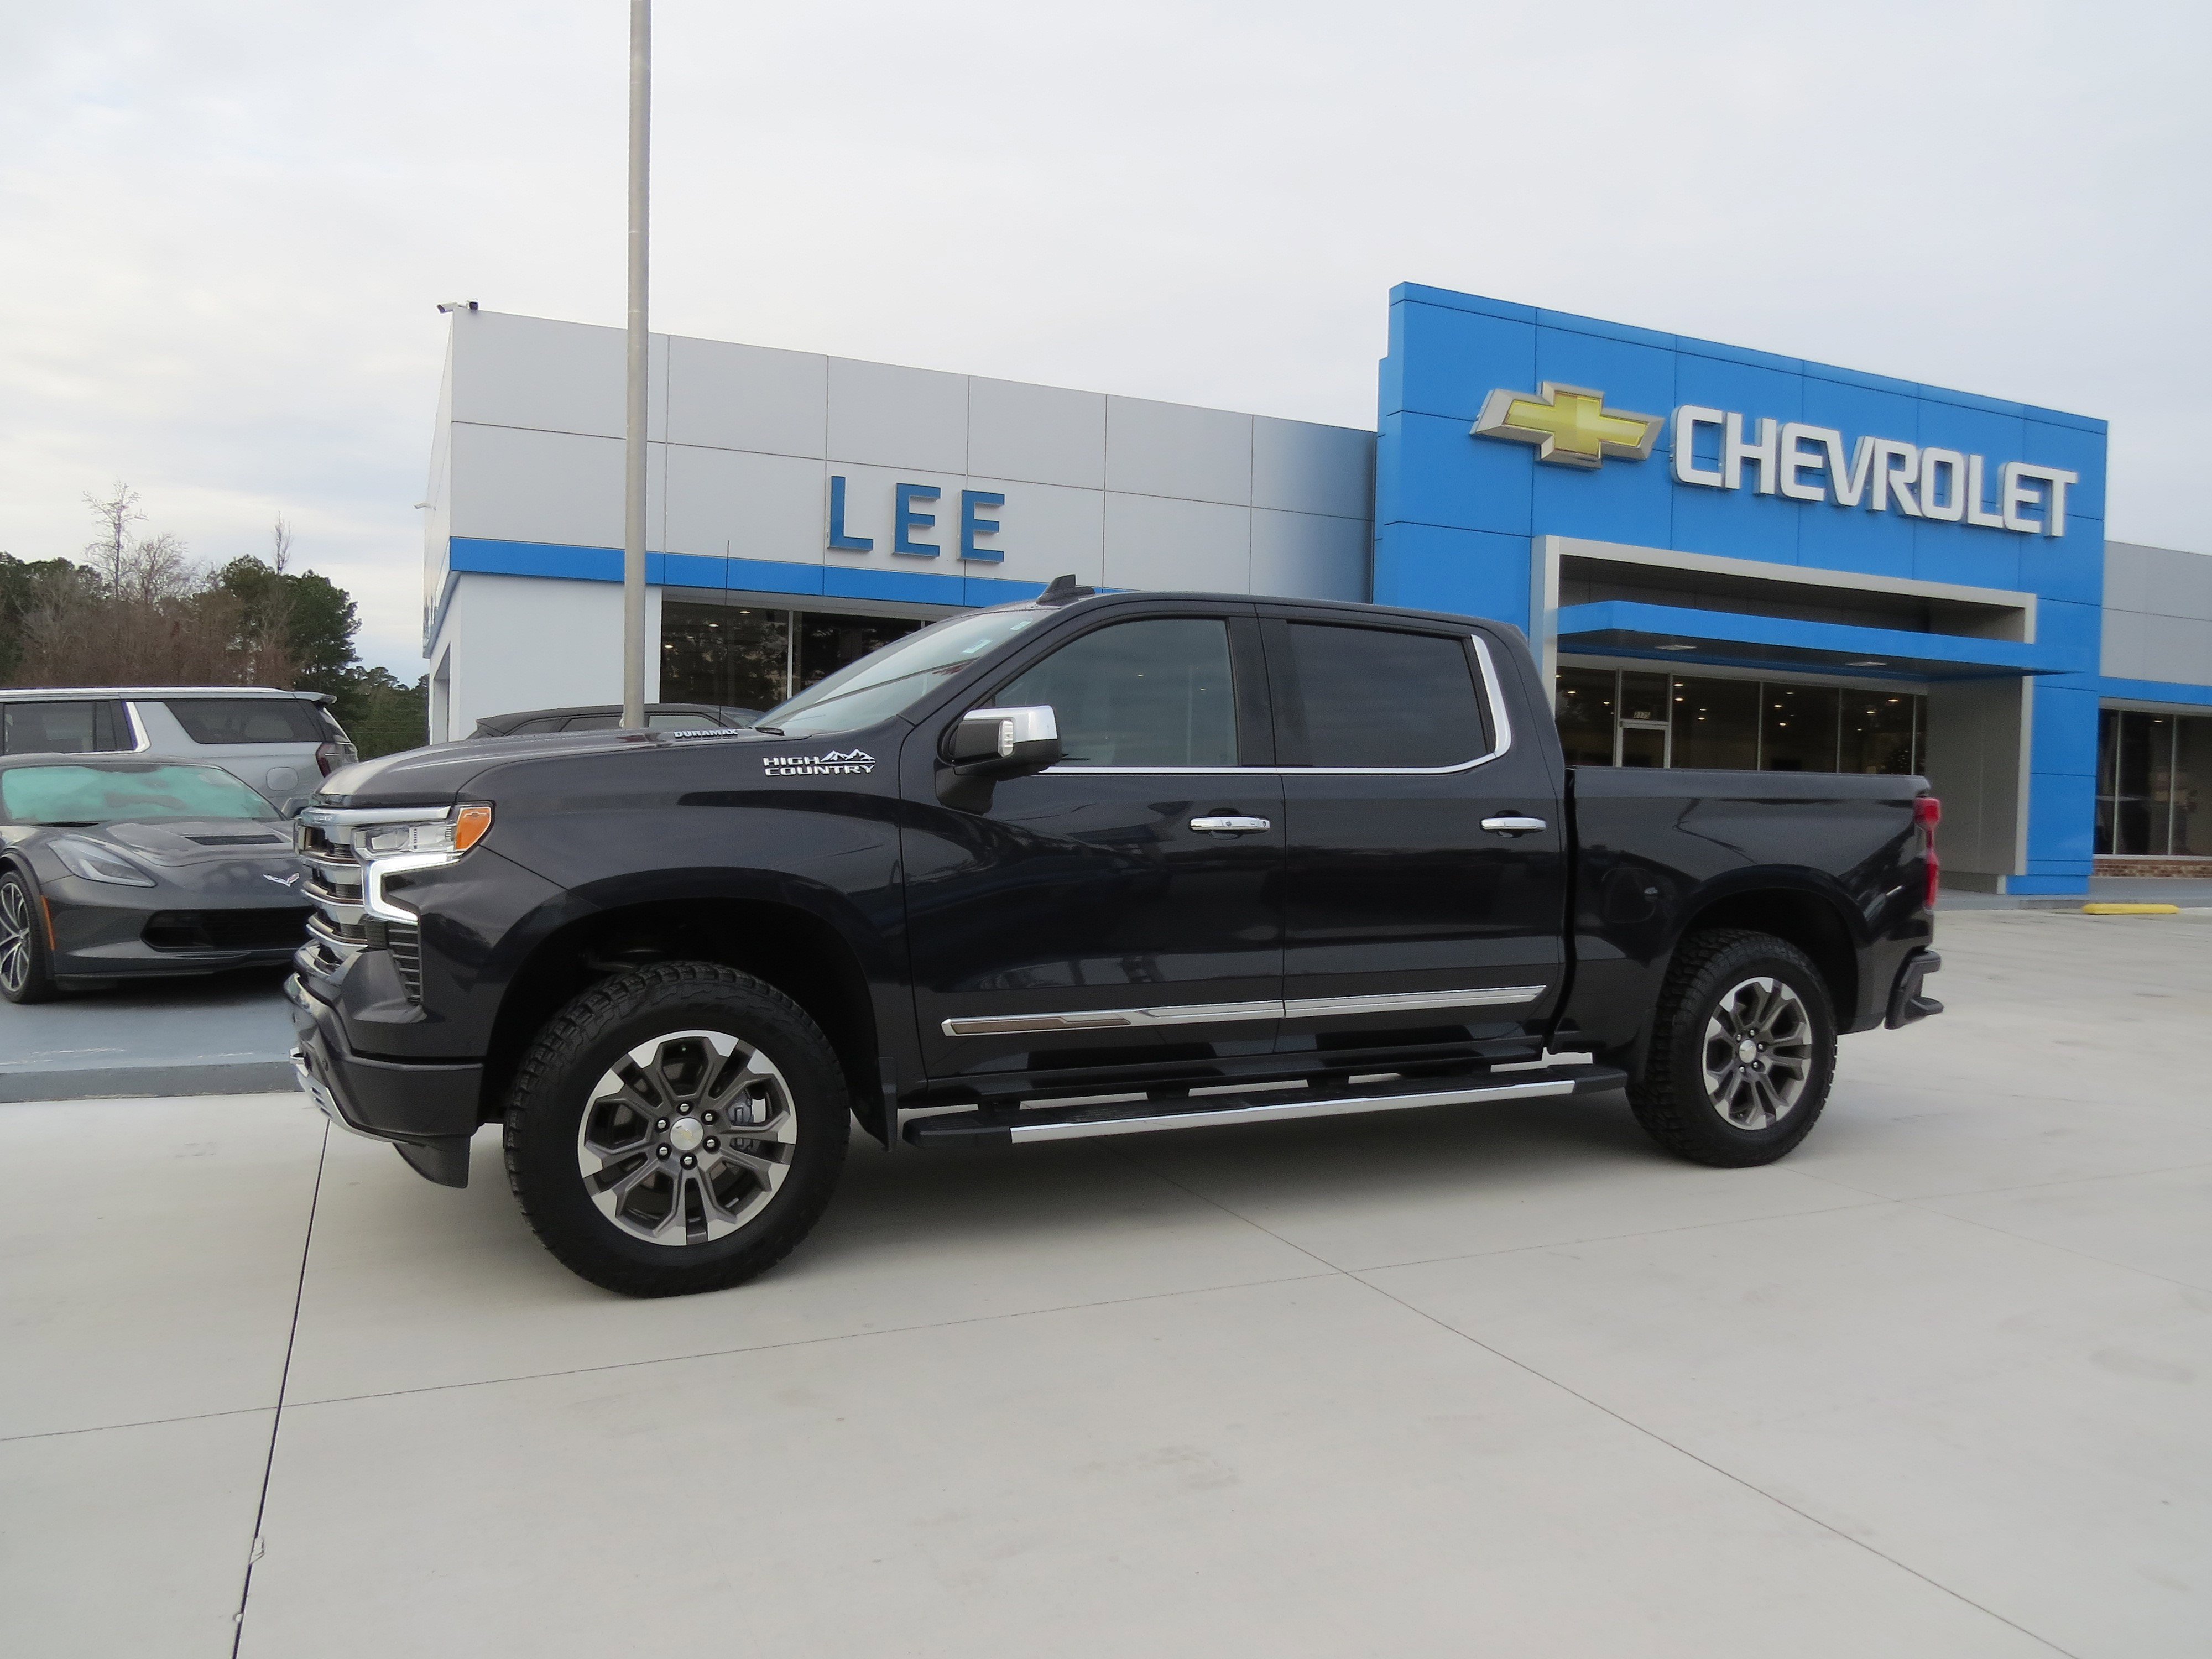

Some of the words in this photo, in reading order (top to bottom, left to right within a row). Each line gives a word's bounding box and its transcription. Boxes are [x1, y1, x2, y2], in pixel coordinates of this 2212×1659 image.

[1670, 405, 2078, 537] CHEVROLET
[828, 476, 1005, 562] LEE
[763, 756, 820, 766] HIGH
[765, 765, 875, 776] COUNTRY
